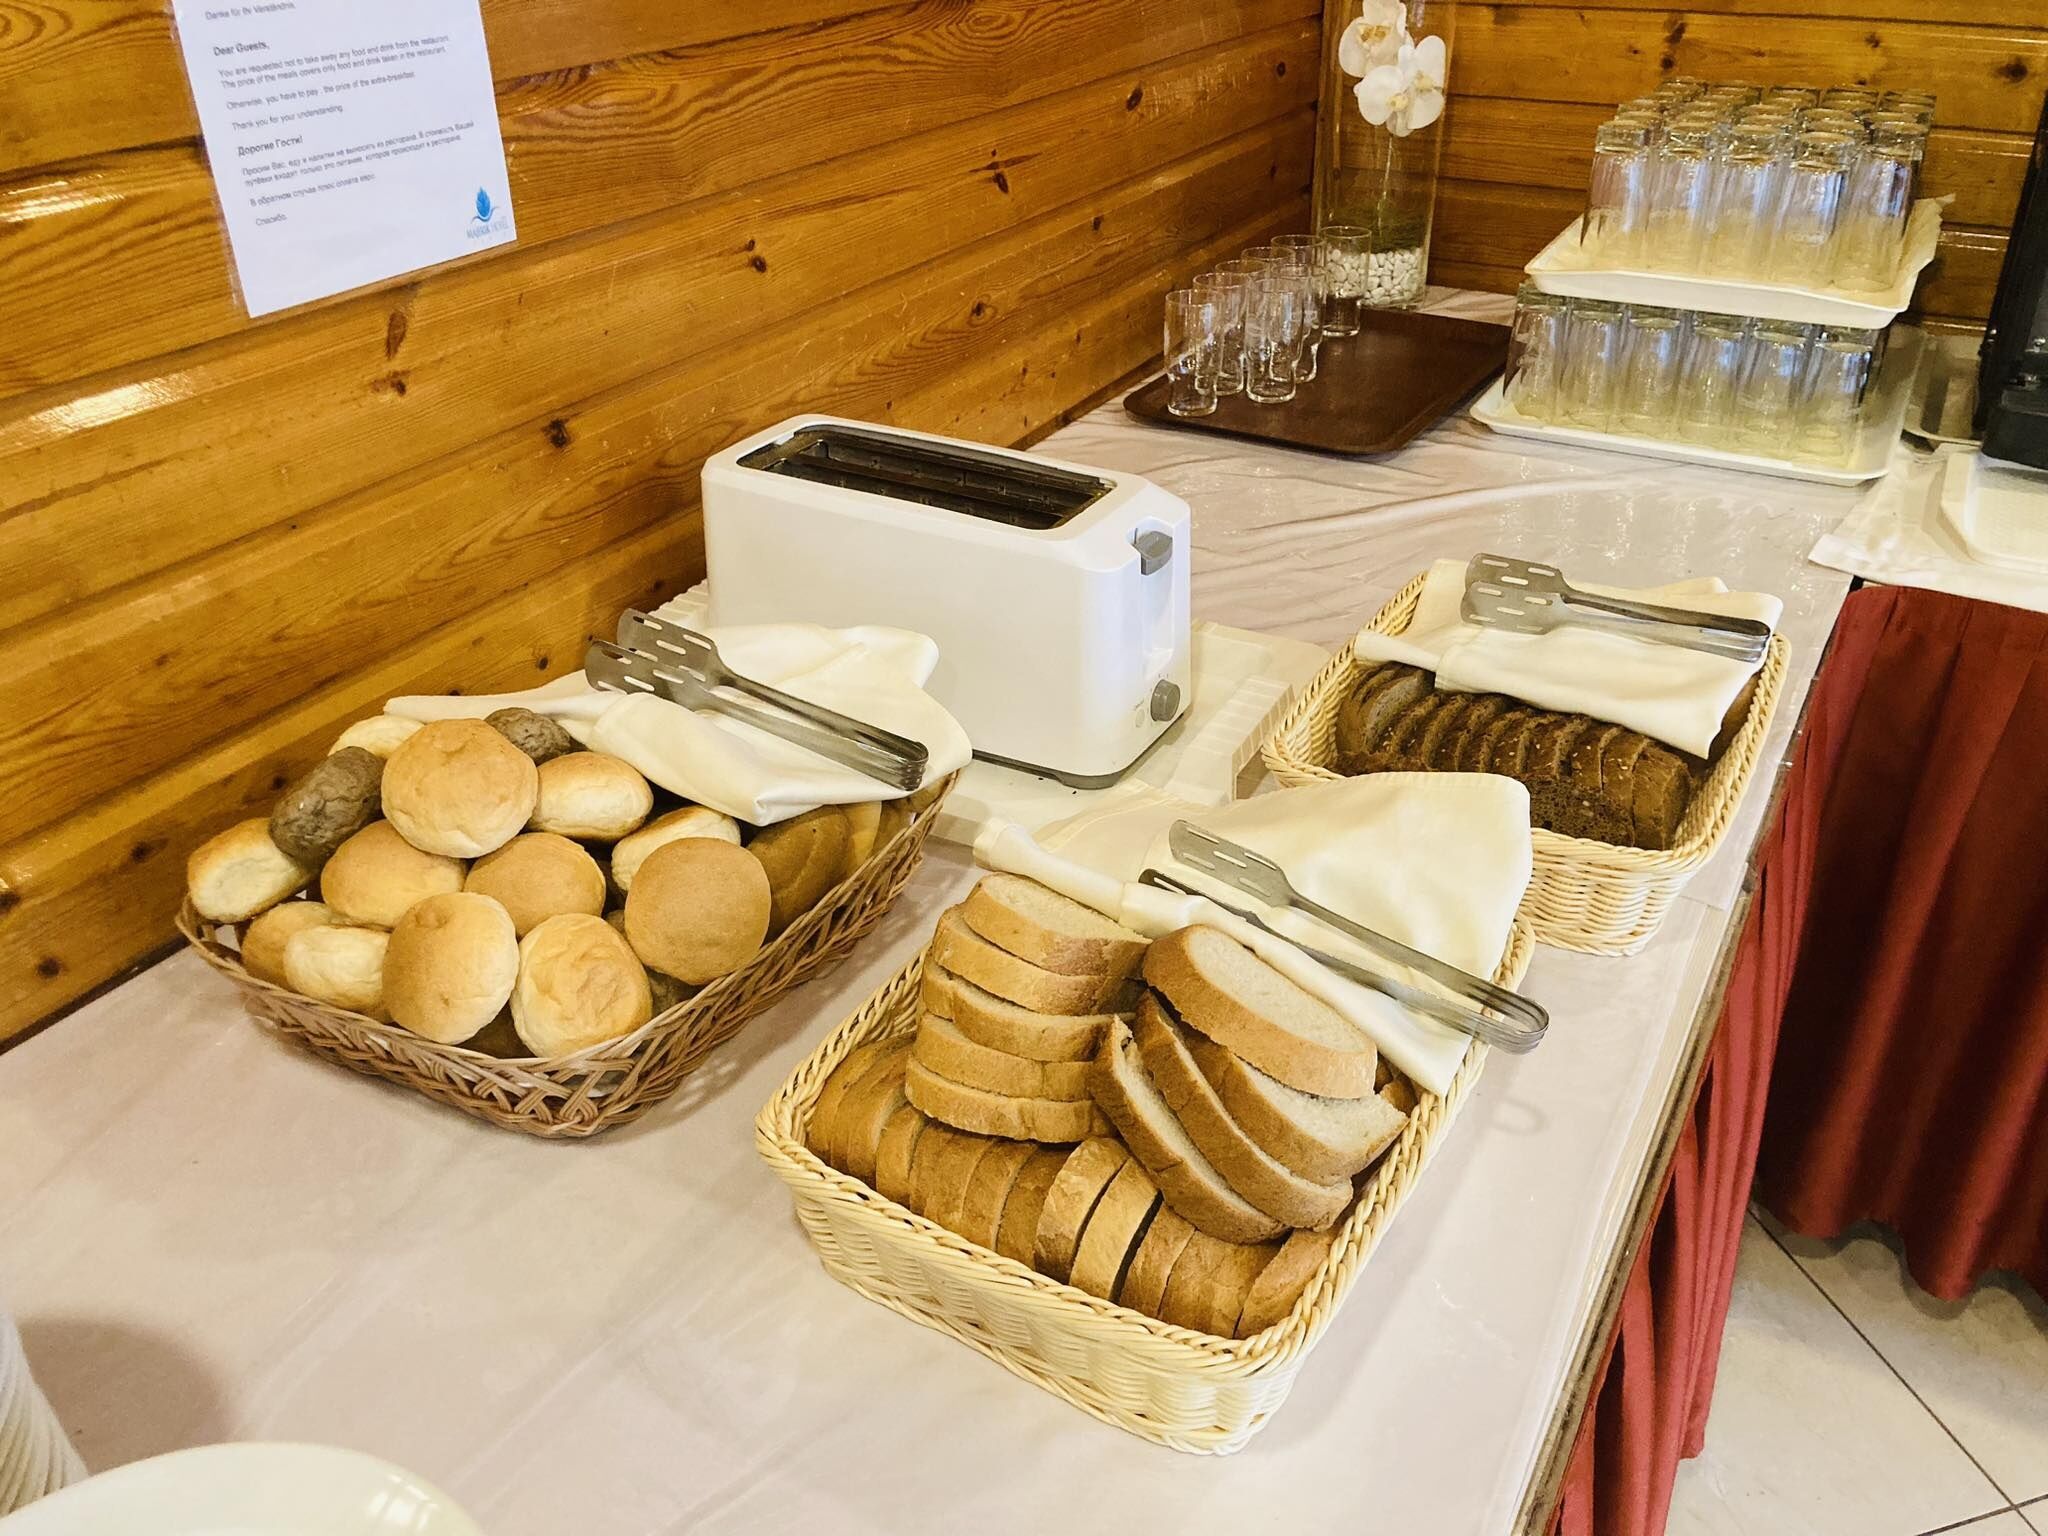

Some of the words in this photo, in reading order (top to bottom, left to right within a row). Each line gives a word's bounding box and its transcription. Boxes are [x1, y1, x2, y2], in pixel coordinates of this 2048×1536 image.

[213, 47, 234, 56] Dear
[249, 62, 282, 72] requested
[367, 46, 378, 54] and
[380, 44, 394, 52] drink
[257, 75, 263, 84] of
[278, 71, 298, 79] meals
[299, 68, 321, 76] covers
[322, 64, 336, 72] only
[366, 57, 380, 65] drink
[266, 96, 278, 104] you
[335, 83, 350, 91] price
[352, 80, 358, 88] of
[232, 122, 253, 130] Thank
[280, 114, 294, 122] your
[238, 143, 274, 156] Дорогие
[275, 136, 302, 147] Гости!
